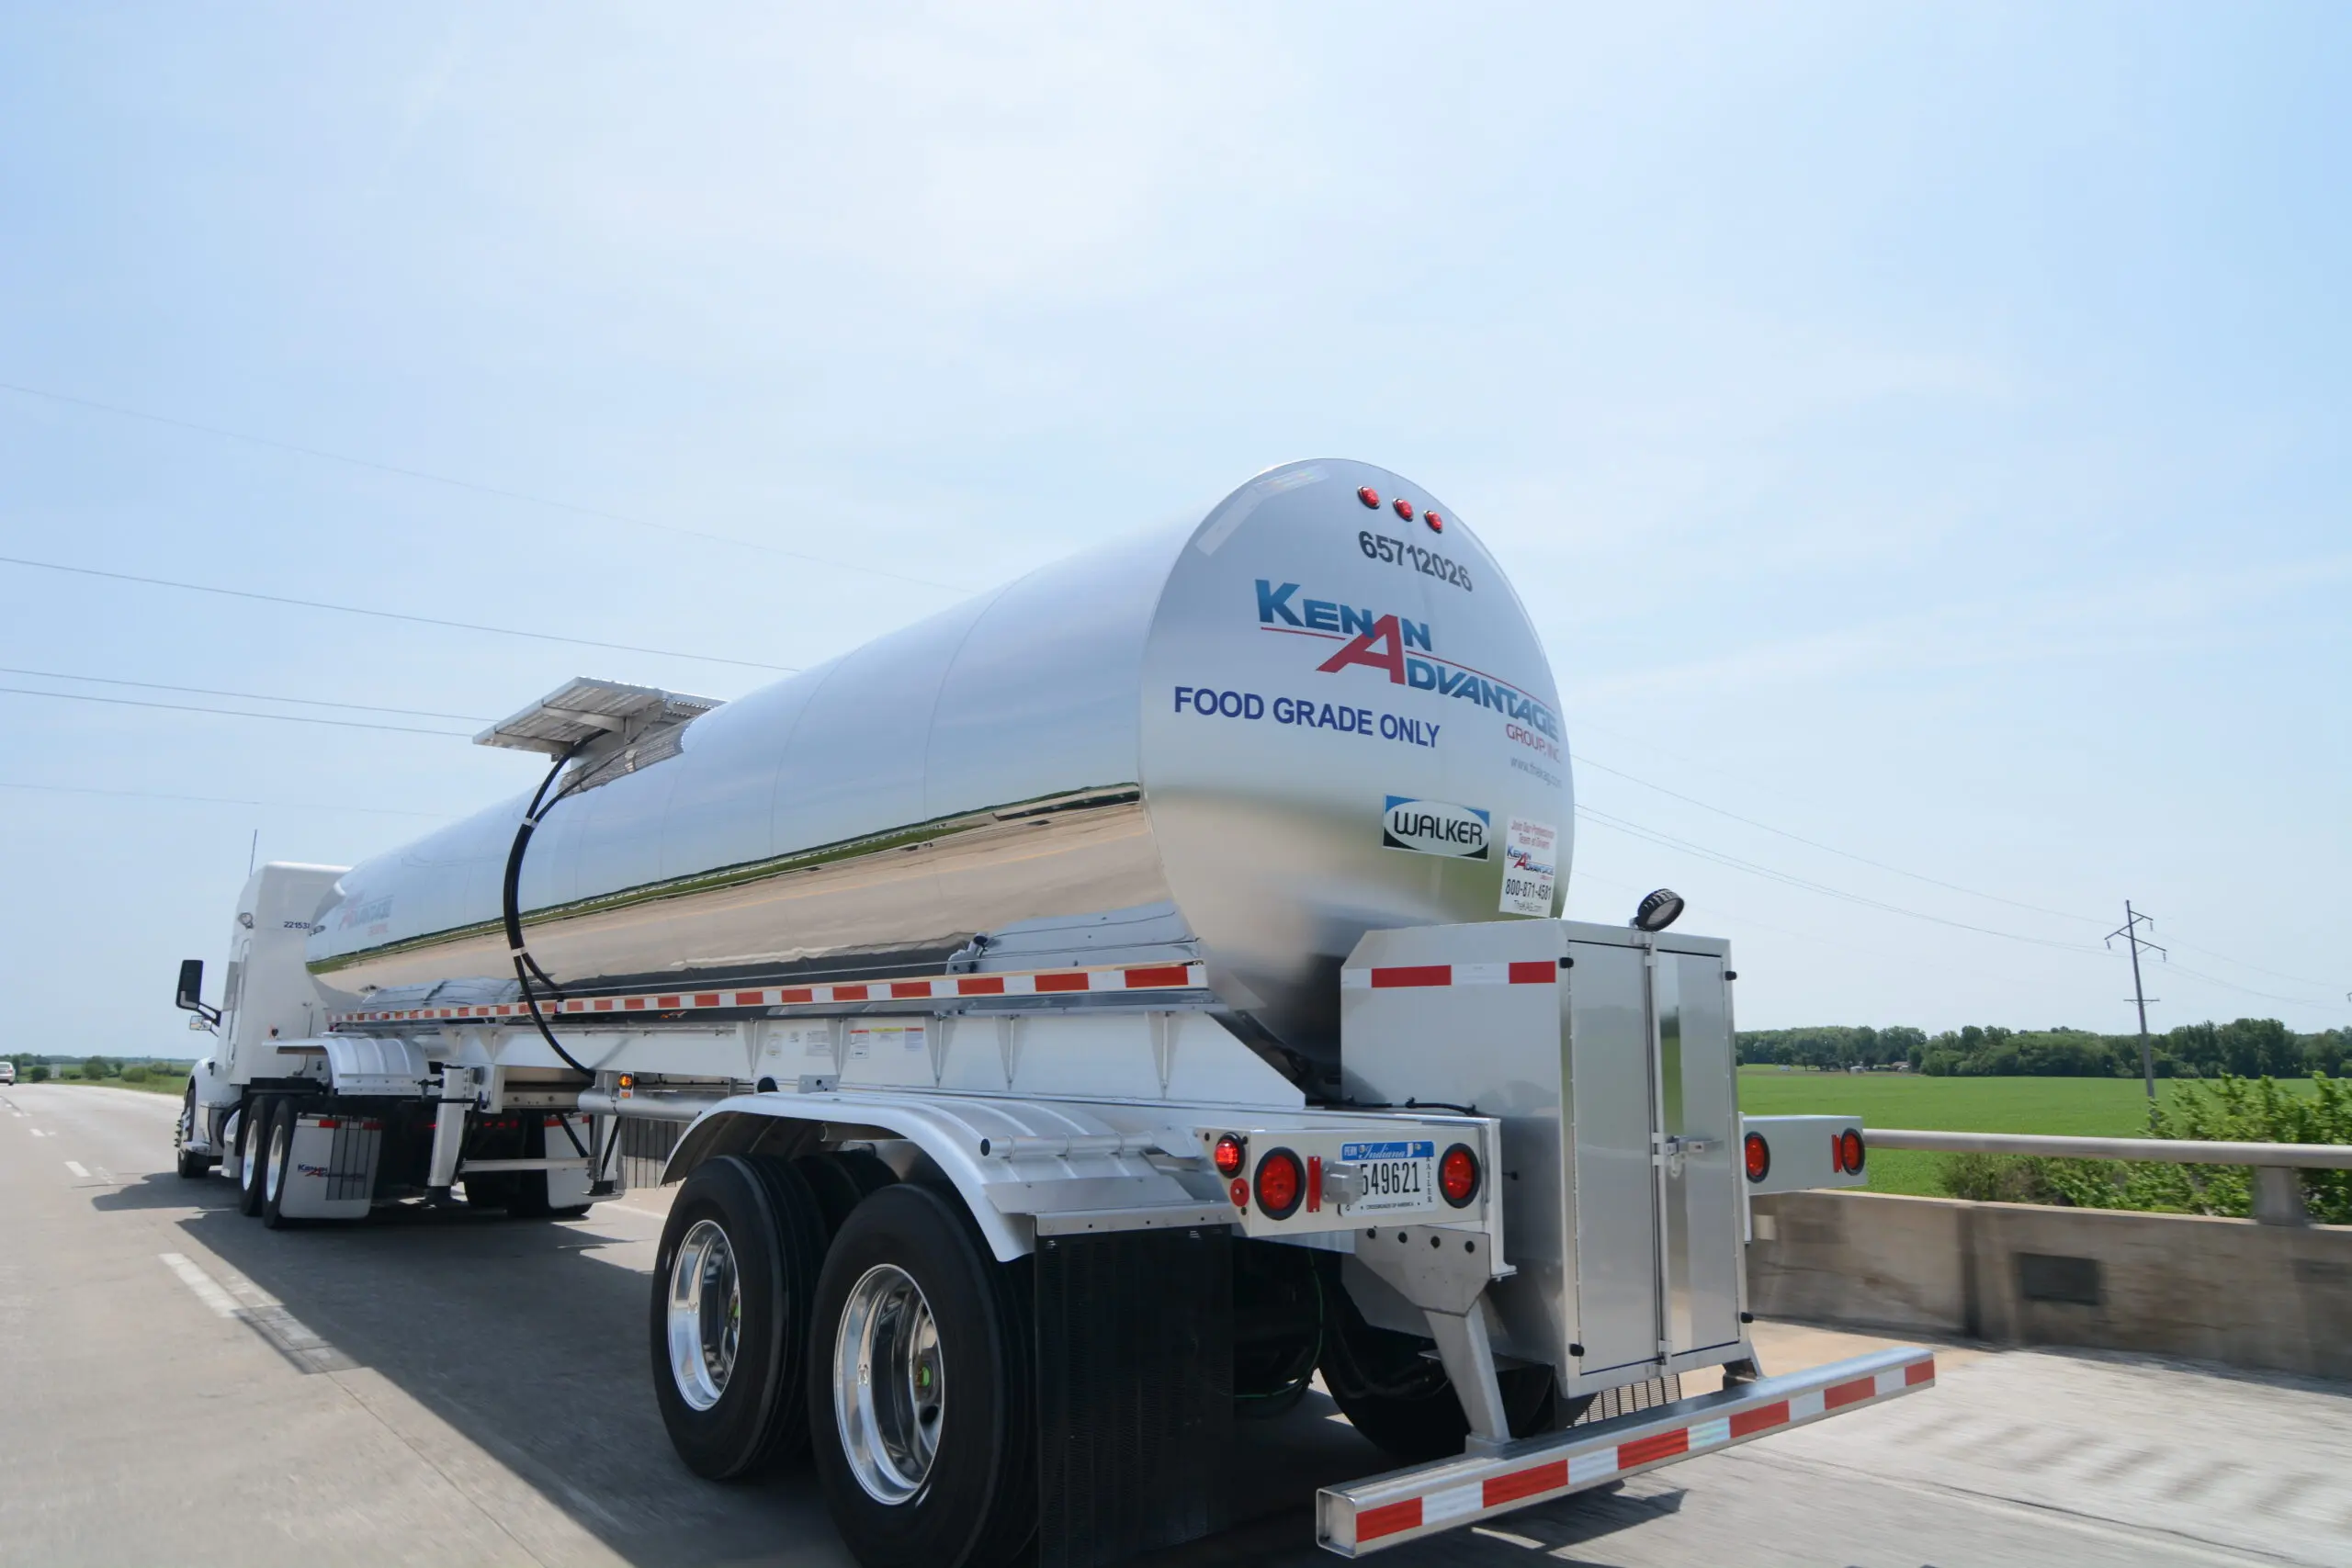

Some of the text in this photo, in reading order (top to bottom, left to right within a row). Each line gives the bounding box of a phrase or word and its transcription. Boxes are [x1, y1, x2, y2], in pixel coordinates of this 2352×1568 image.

[1358, 530, 1474, 592] 65712026
[1255, 579, 1433, 660] KENAN
[1173, 686, 1441, 749] FOOD GRADE ONLY
[1393, 811, 1483, 846] WALKER
[1359, 1143, 1407, 1159] Indiana
